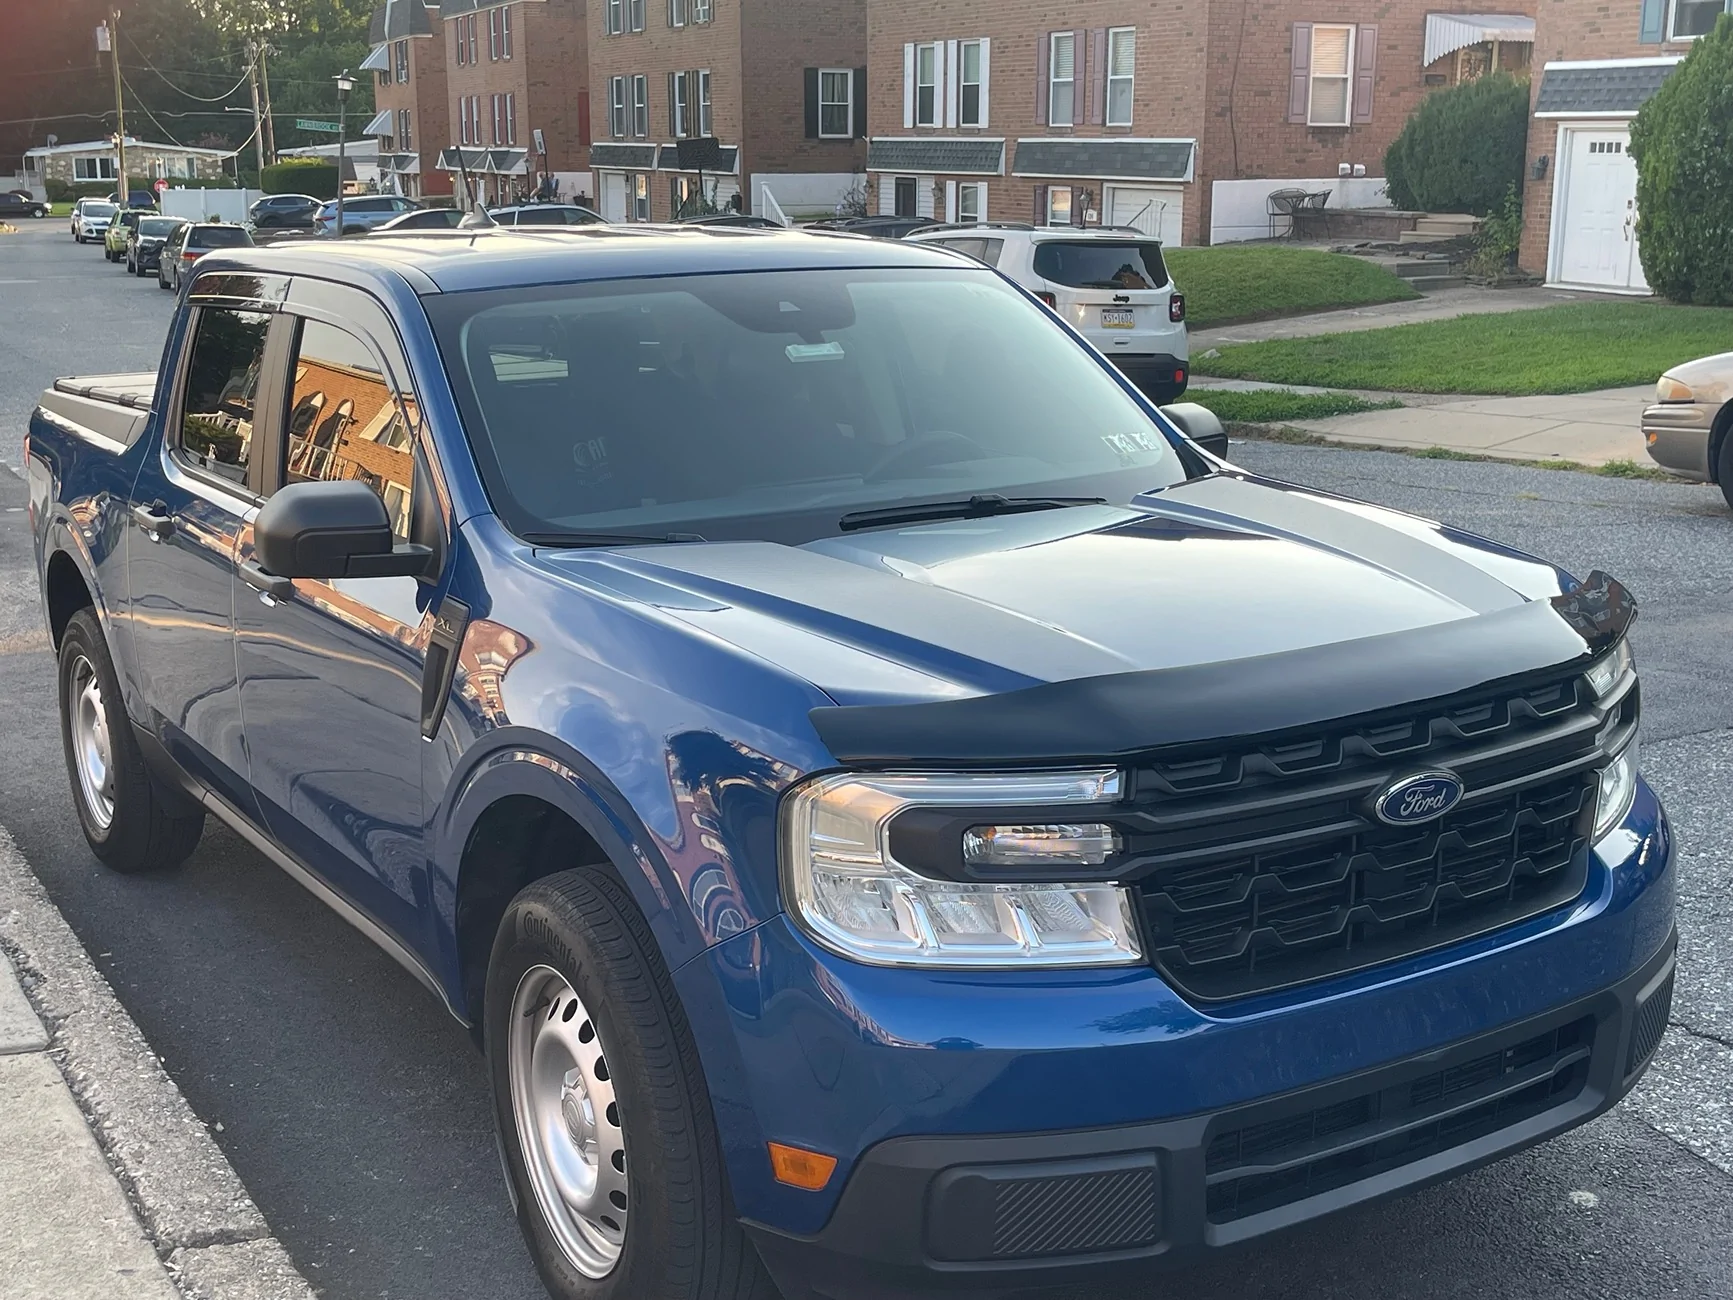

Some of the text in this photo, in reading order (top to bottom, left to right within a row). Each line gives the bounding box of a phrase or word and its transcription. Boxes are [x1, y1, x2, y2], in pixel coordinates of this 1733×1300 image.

[1112, 294, 1130, 303] Jeep
[437, 616, 455, 634] XL
[1400, 784, 1446, 816] Ford
[523, 910, 583, 978] Continental
